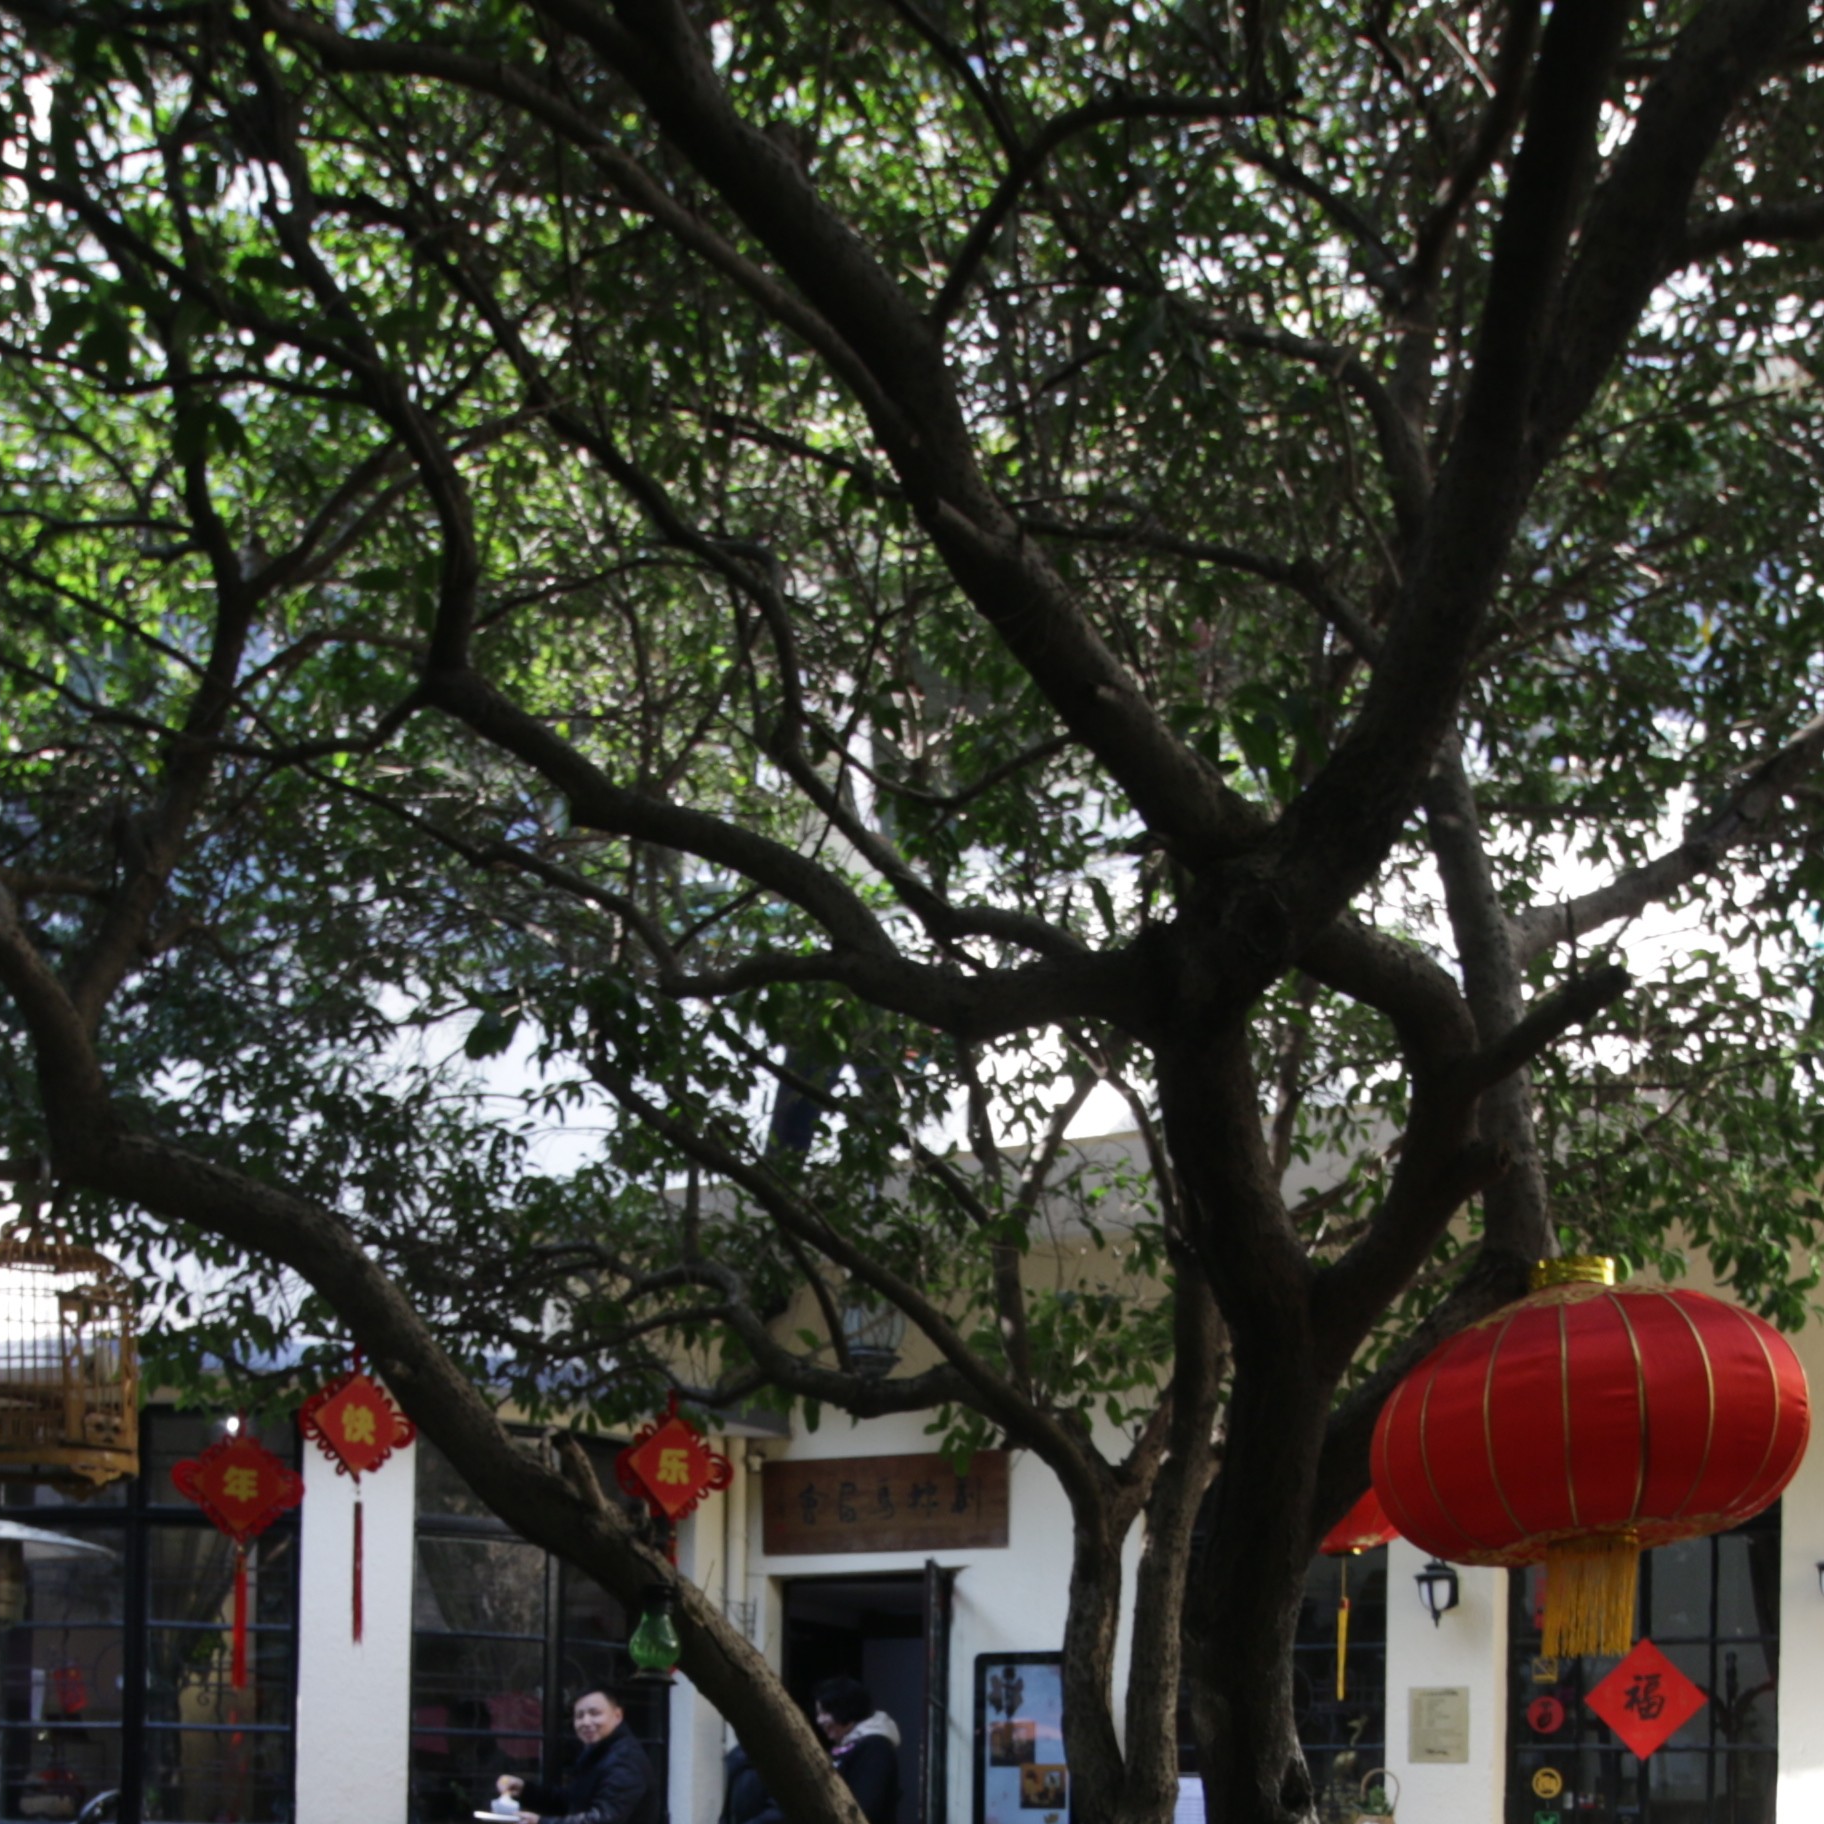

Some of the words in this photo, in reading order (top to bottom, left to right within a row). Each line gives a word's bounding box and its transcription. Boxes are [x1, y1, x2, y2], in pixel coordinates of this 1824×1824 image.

[340, 1401, 378, 1446] 快
[222, 1464, 259, 1503] 年
[655, 1447, 691, 1486] 乐
[1623, 1672, 1667, 1721] 福
